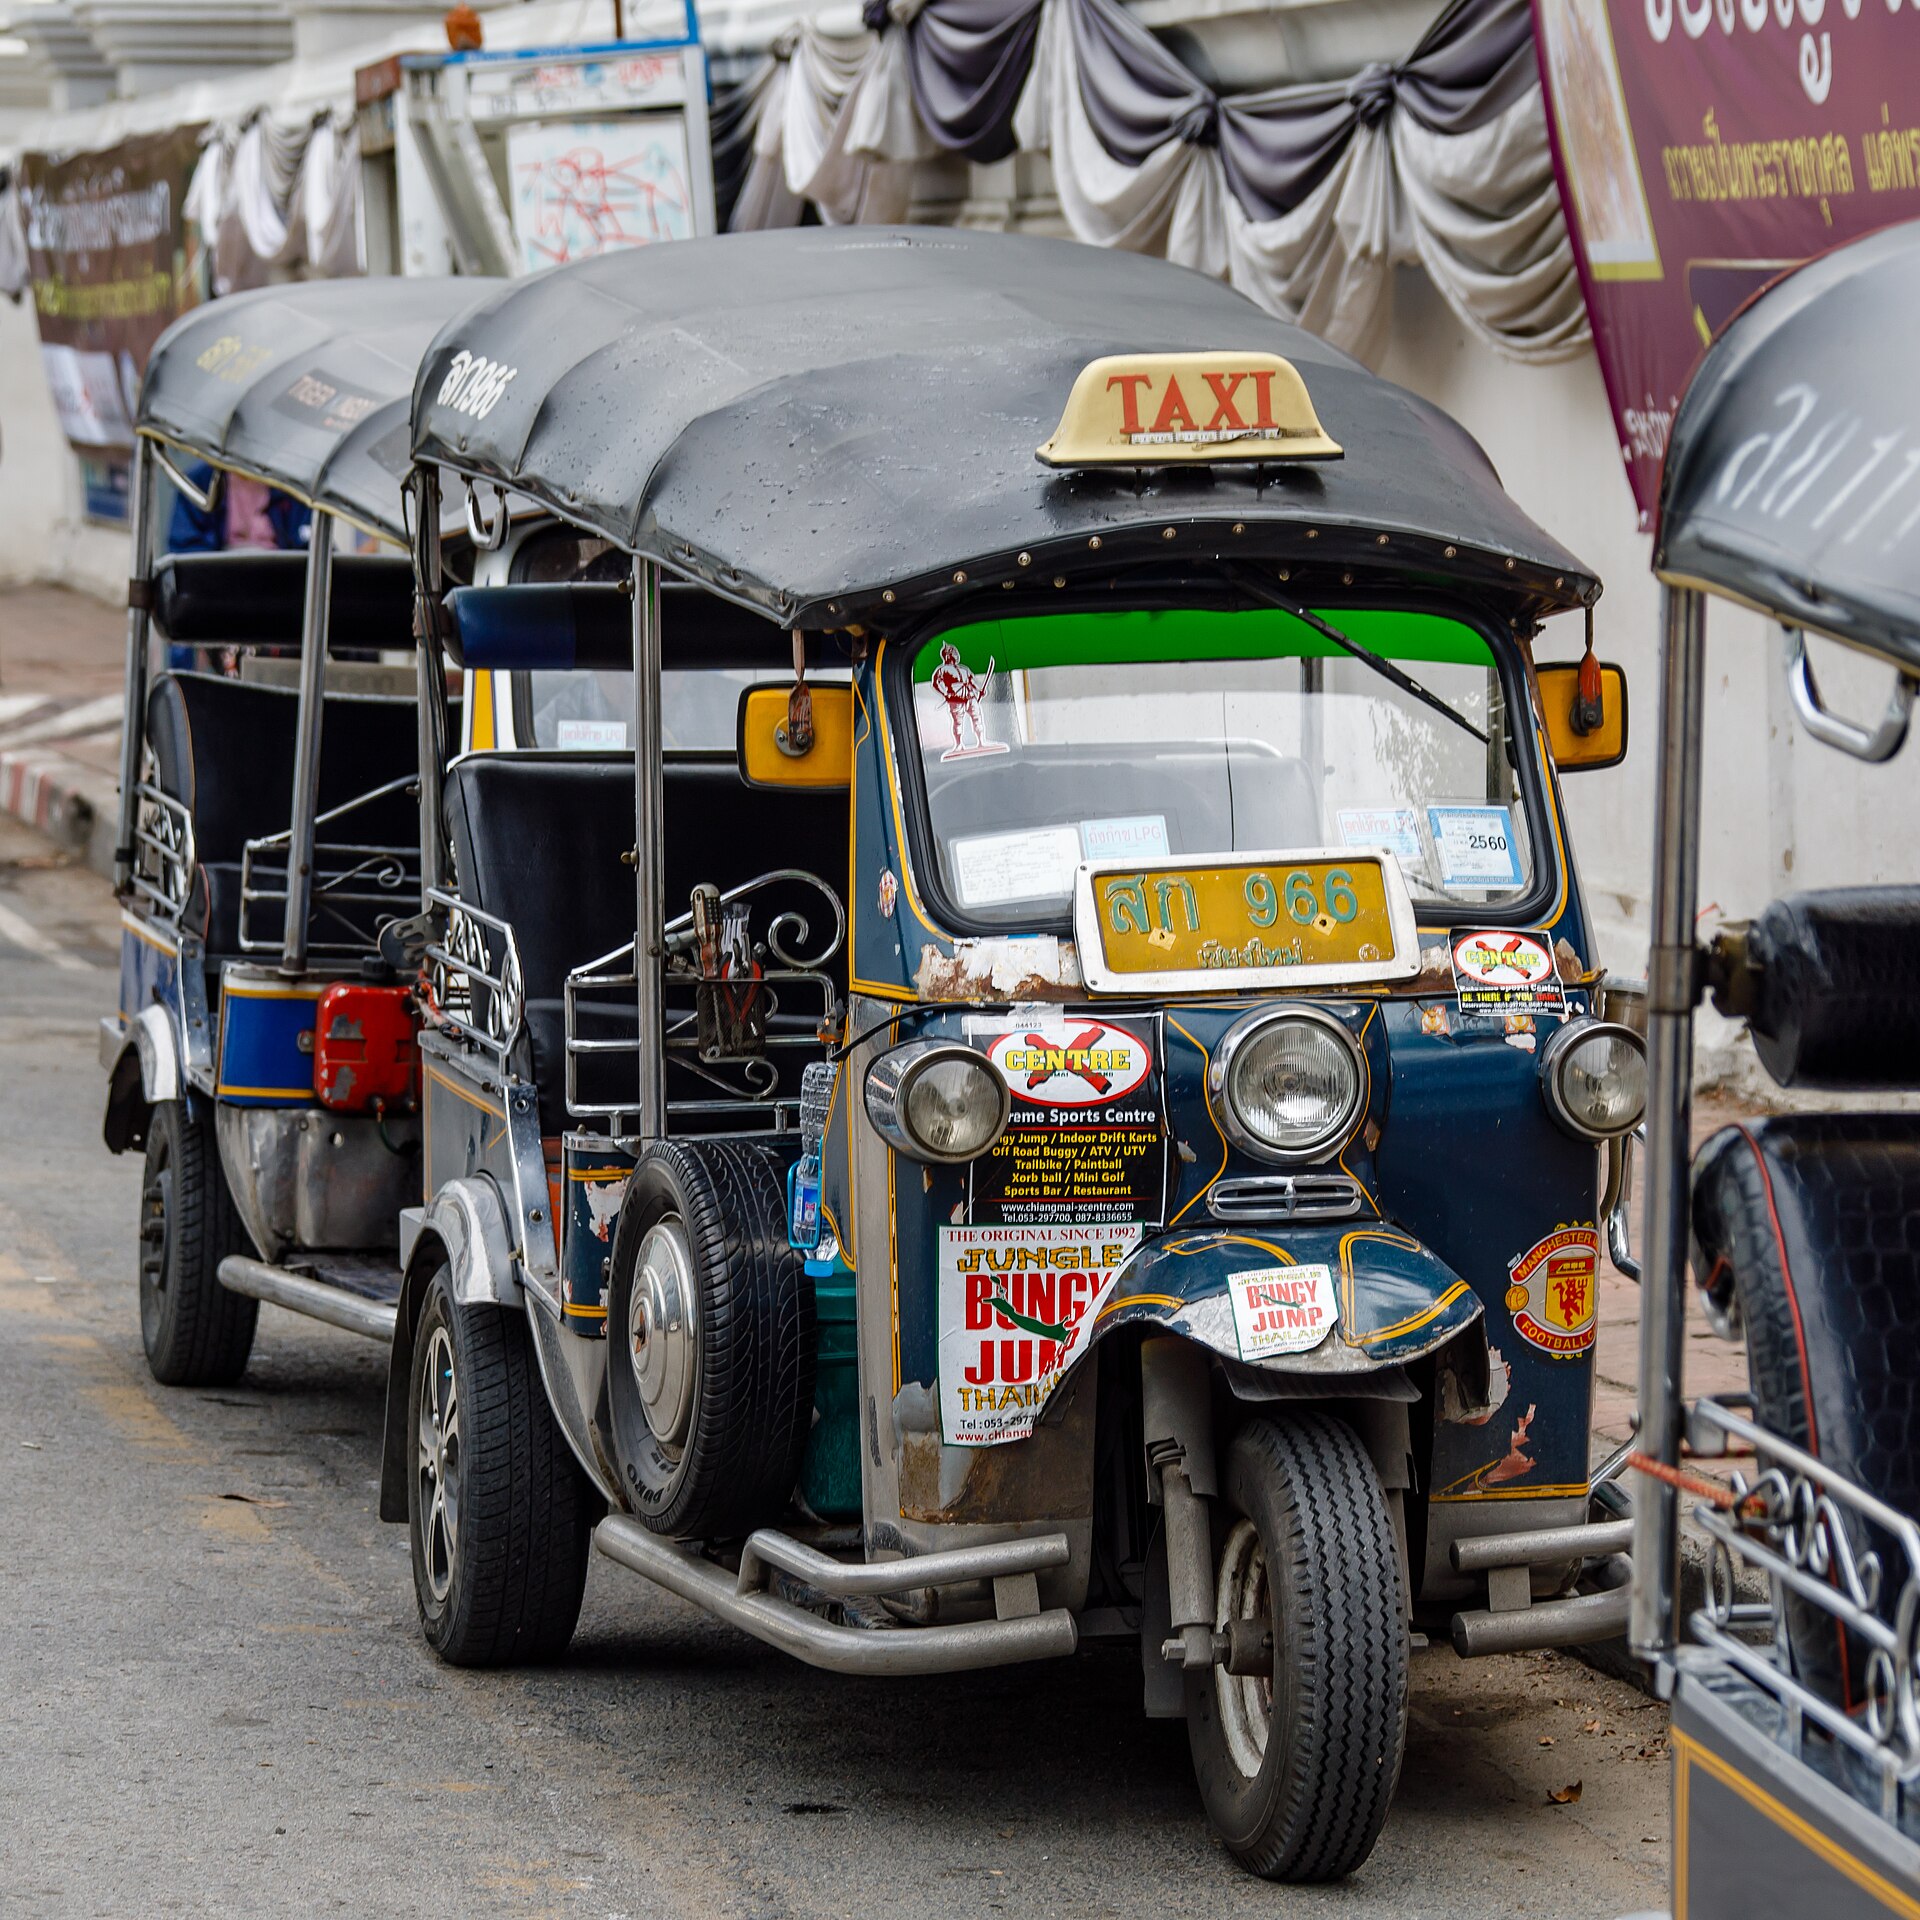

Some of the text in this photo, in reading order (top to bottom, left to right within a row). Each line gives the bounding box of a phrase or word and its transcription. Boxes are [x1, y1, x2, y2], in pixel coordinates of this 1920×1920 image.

[1106, 370, 1279, 434] TAXI
[1134, 825, 1162, 841] LPG
[1468, 834, 1507, 851] 2560
[1106, 869, 1358, 934] สก 966
[1197, 936, 1303, 969] เชียงใหม่
[1465, 950, 1541, 966] CENTRE
[1475, 992, 1501, 1002] THERE
[1515, 992, 1533, 1002] YOU
[1005, 1049, 1131, 1071] CENTRE
[1008, 1108, 1156, 1126] reme Sports Centre
[1018, 1133, 1048, 1145] Jump
[1059, 1132, 1097, 1143] Indoor
[1100, 1131, 1126, 1143] Drift
[1129, 1131, 1157, 1143] Karts
[992, 1146, 1010, 1157] Off
[1013, 1146, 1040, 1157] Road
[1043, 1146, 1078, 1159] Buggy
[1089, 1145, 1112, 1157] ATV
[1123, 1145, 1146, 1156] UTV
[1015, 1158, 1062, 1170] Trailbike
[1074, 1158, 1122, 1170] Paintball
[1012, 1172, 1038, 1183] Xorb
[1041, 1172, 1062, 1183] ball
[1073, 1172, 1099, 1183] Mini
[1101, 1171, 1125, 1183] Golf
[1004, 1185, 1040, 1198] Sports
[1043, 1185, 1062, 1196] Bar
[1073, 1184, 1132, 1196] Restaurant
[1001, 1201, 1135, 1214] www.chiangmai-xcentre.com
[1075, 1211, 1133, 1222] 087-8336655
[947, 1226, 1136, 1243] THE ORIGINAL SINCE 1992
[957, 1243, 1124, 1272] JUNGLE
[1517, 1231, 1592, 1278] MANCHESTER
[965, 1271, 1113, 1331] BUNGY
[1246, 1279, 1318, 1310] BUNGY
[1252, 1307, 1323, 1333] JUMP
[1521, 1320, 1588, 1350] FOOTBALL
